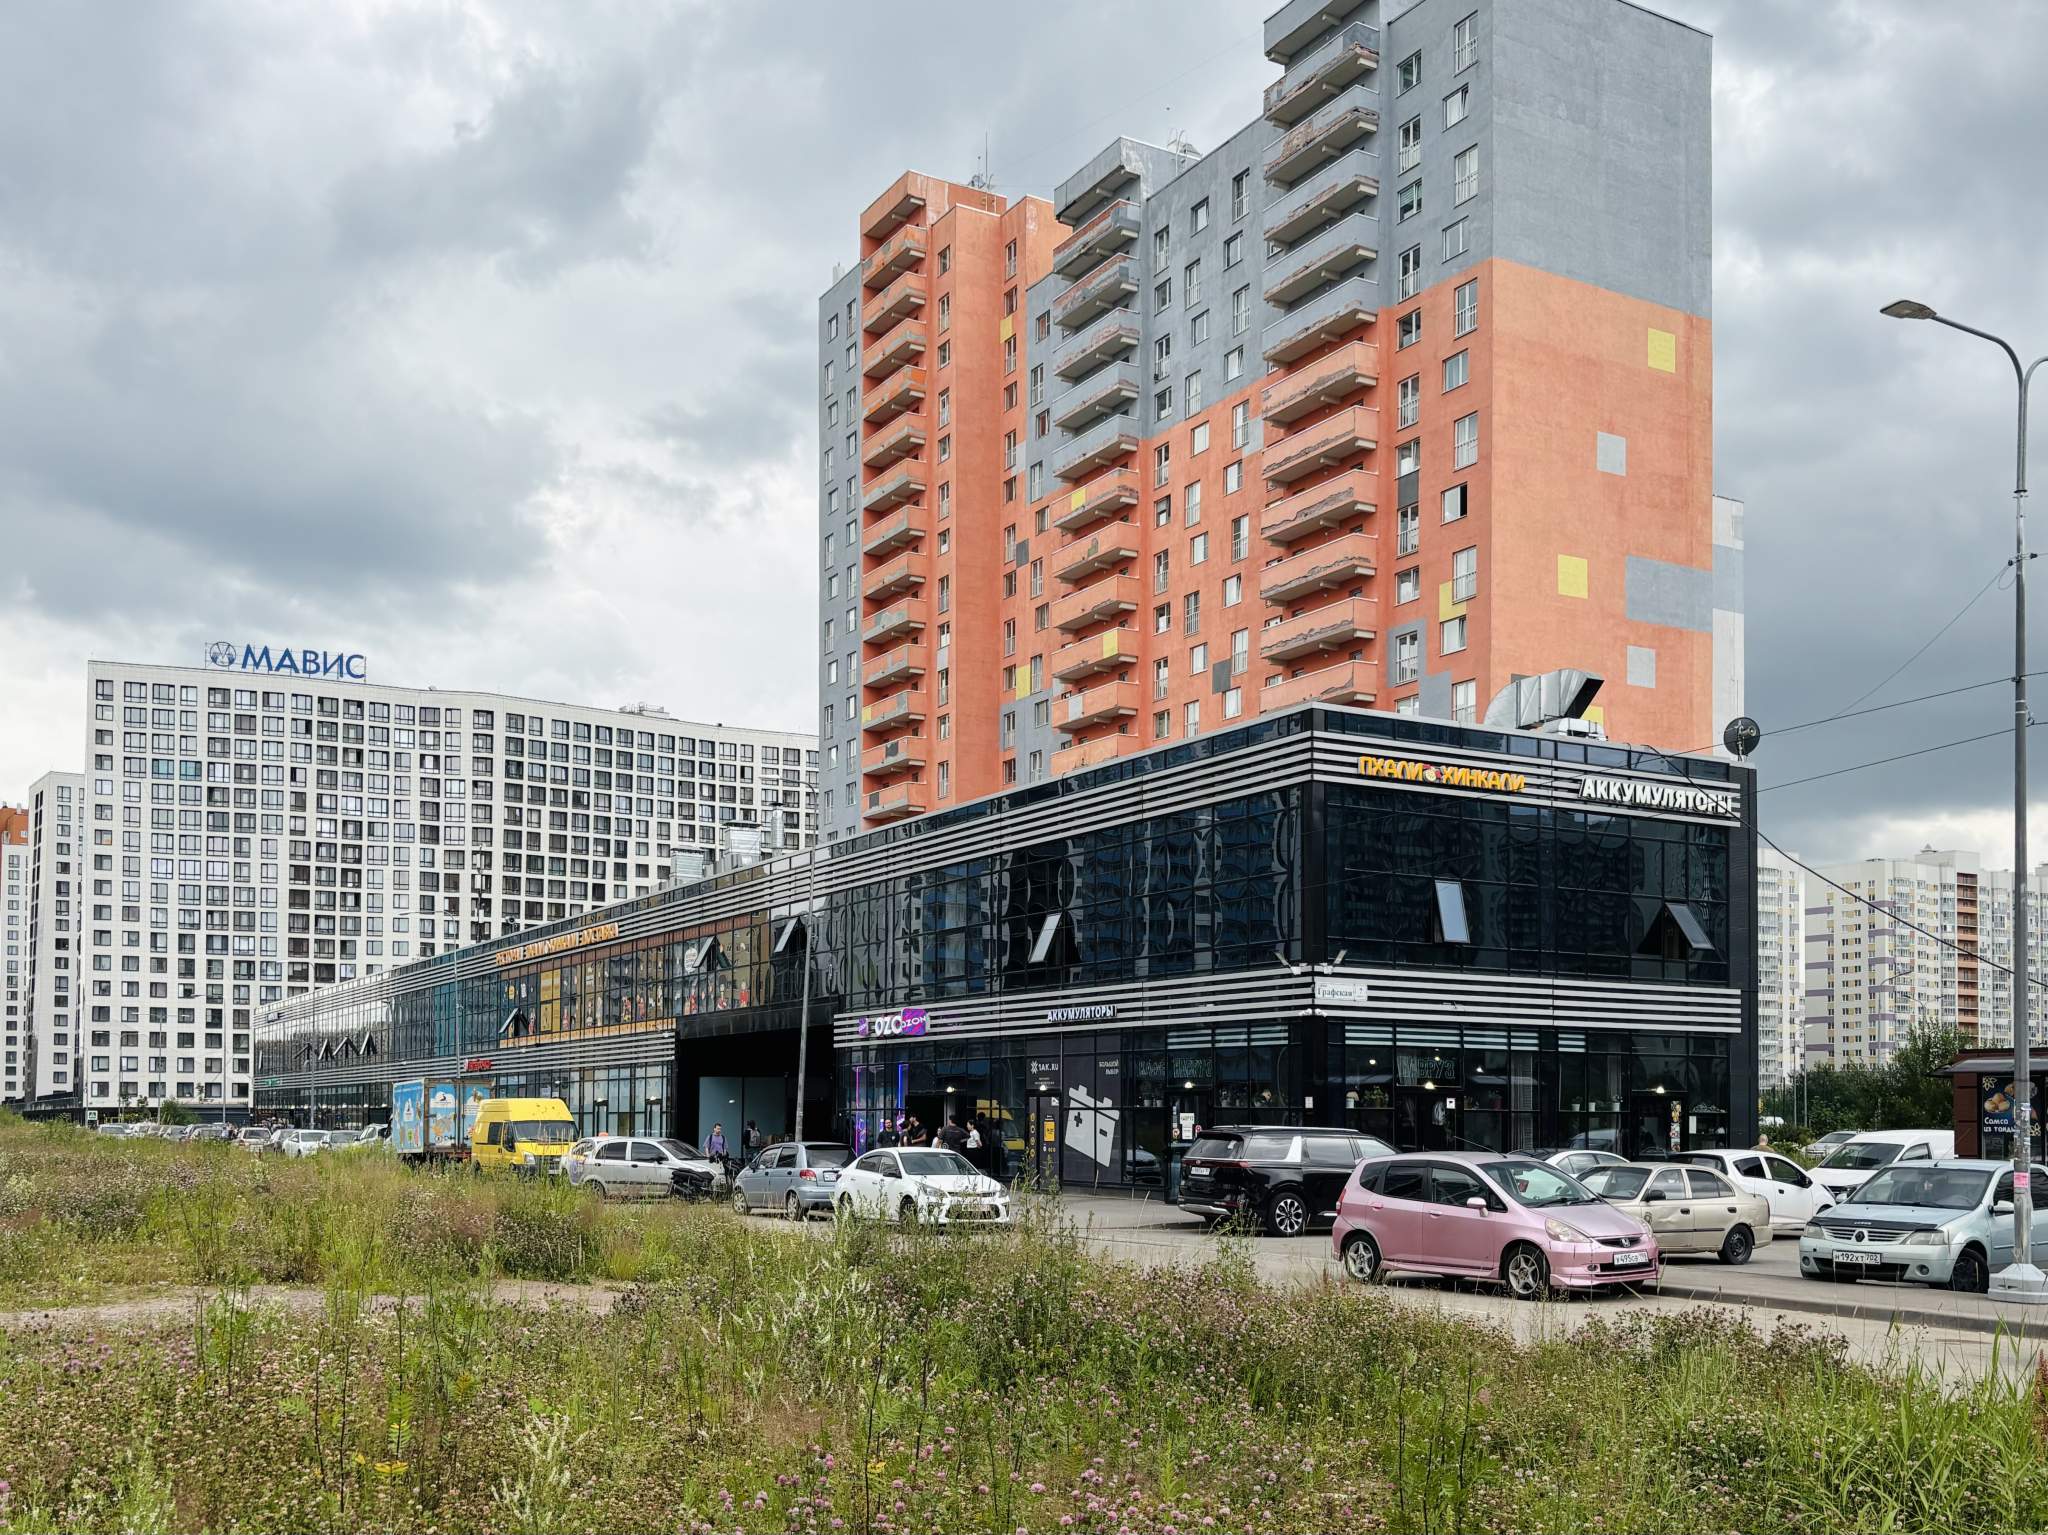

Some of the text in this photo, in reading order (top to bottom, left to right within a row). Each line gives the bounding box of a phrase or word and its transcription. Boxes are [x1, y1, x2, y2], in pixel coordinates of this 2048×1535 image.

[241, 643, 366, 679] МАВИС
[1358, 756, 1525, 792] ПХАЛИ ХИНКАЛИ
[1581, 777, 1732, 814] АККУМУЛЯТОРЫ
[901, 1016, 926, 1028] OZON
[1047, 1005, 1115, 1022] АККУМУЛЯТОРЫ
[875, 1015, 902, 1036] OZO
[1984, 1116, 2009, 1125] Самса
